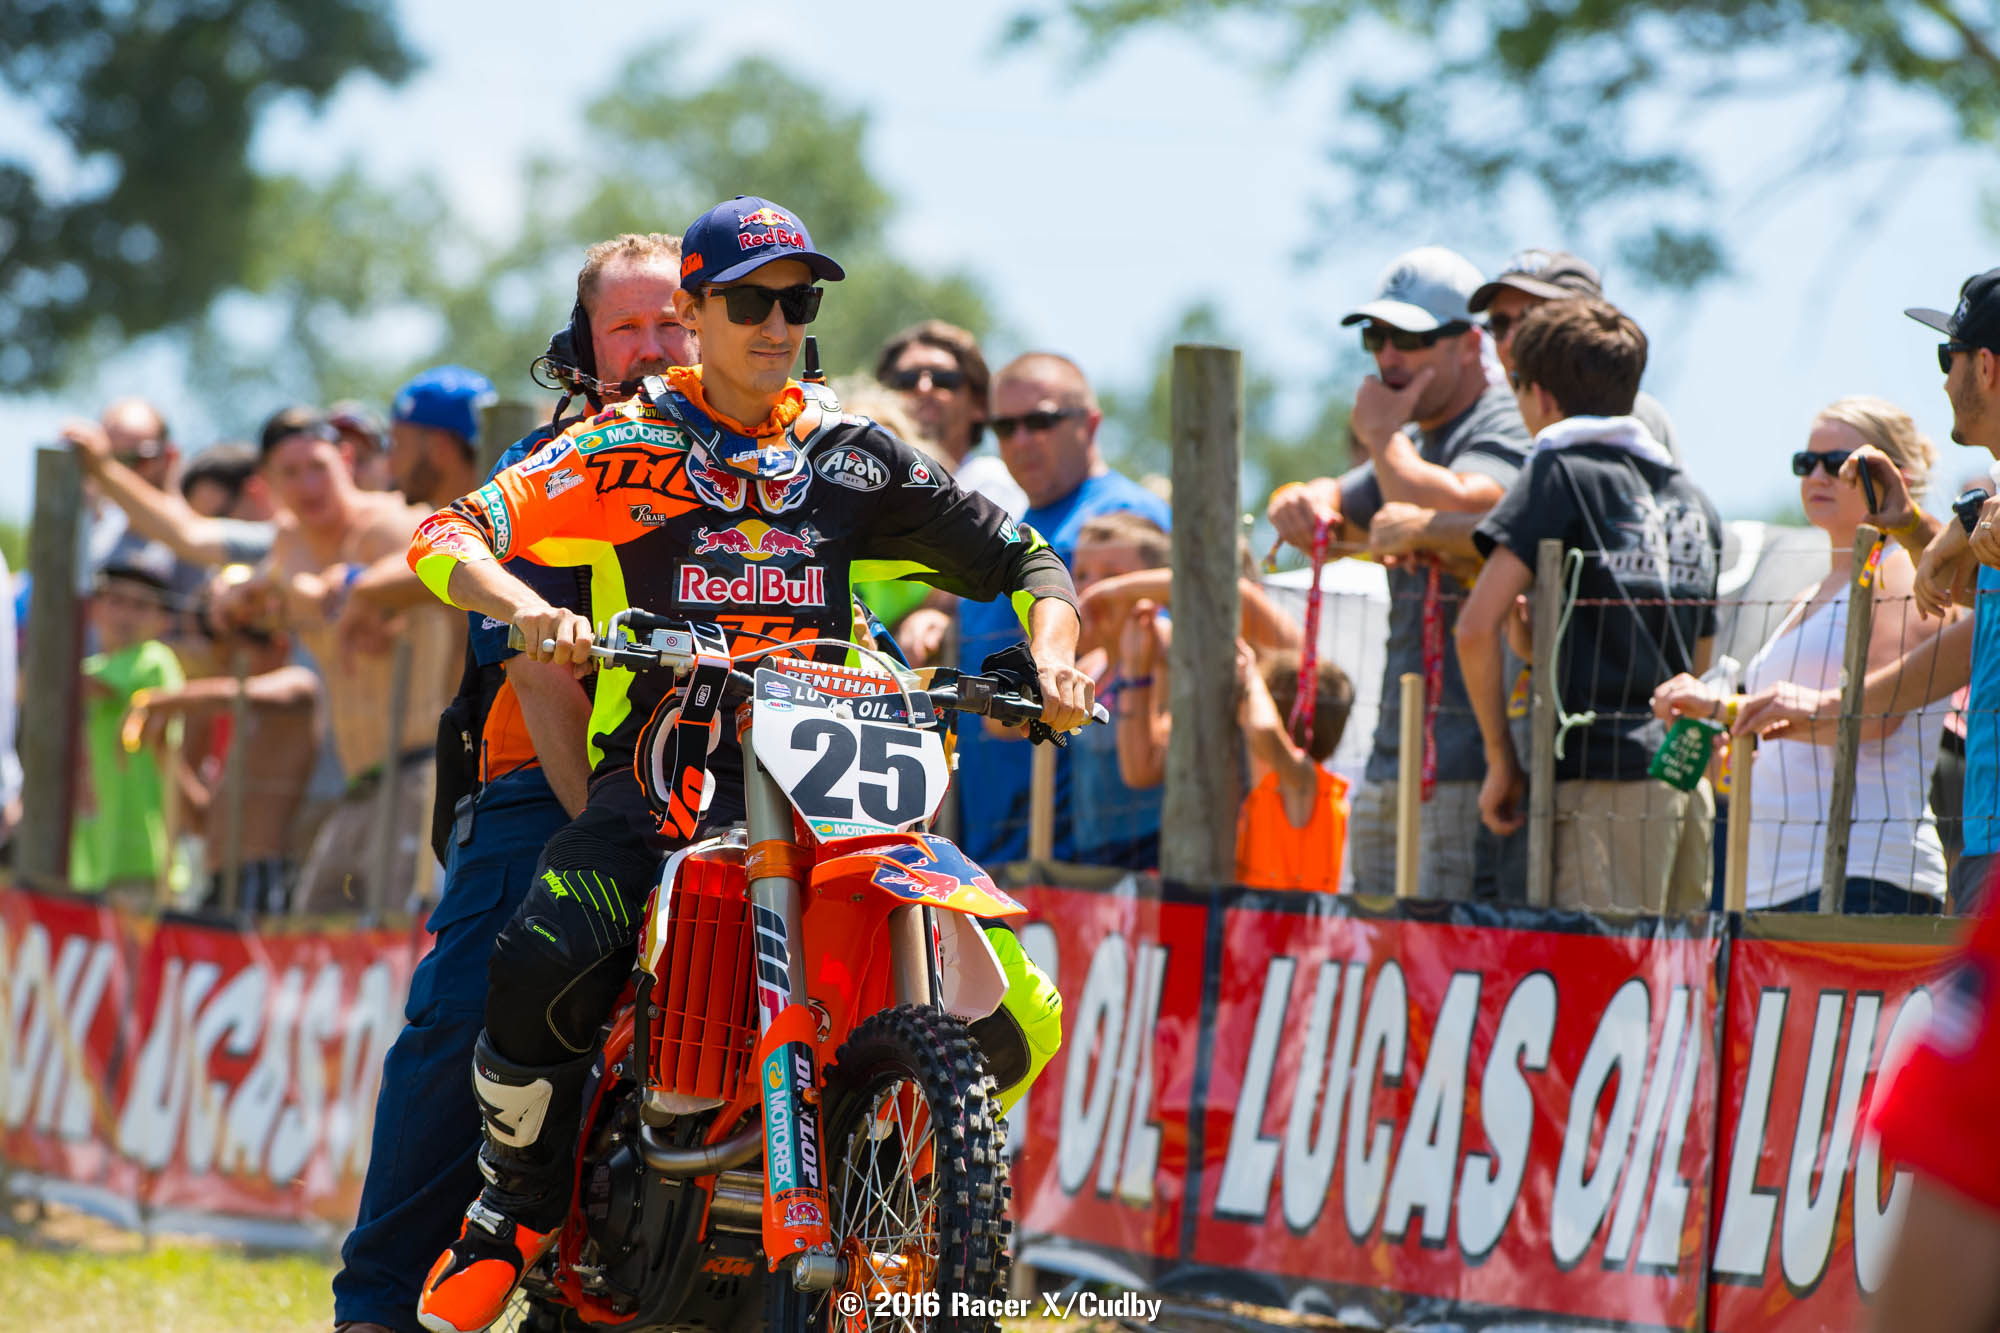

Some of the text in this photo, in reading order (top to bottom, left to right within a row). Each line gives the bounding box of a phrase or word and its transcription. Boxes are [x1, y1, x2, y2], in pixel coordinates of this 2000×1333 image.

[738, 228, 806, 250] Red Bull
[606, 424, 685, 447] MOTOREX
[485, 490, 511, 556] MOTOREX
[679, 564, 826, 607] Red Bull
[790, 718, 927, 826] 25
[1058, 931, 1170, 1208] OIL
[769, 1089, 793, 1189] MOTOREX
[1213, 955, 1559, 1267] LUCAS
[1550, 975, 1702, 1277] OIL
[1710, 984, 1934, 1304] LUC
[700, 1255, 756, 1278] KTM
